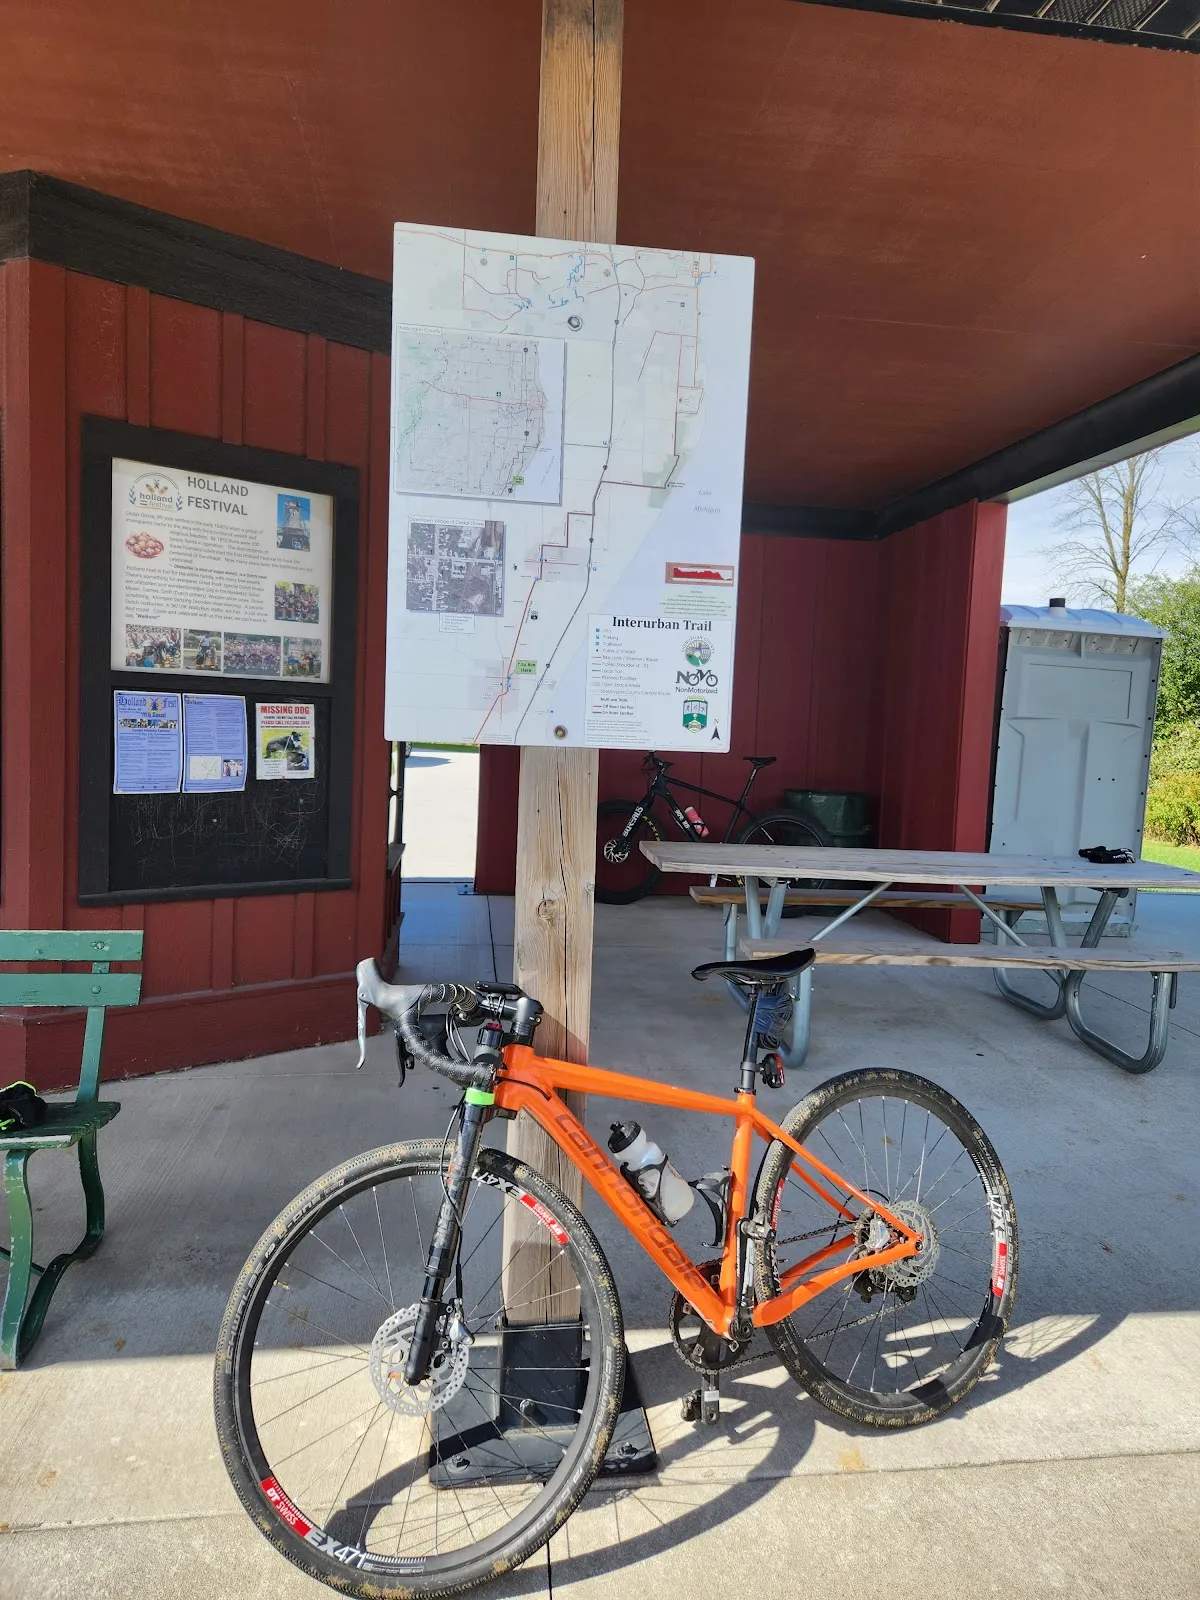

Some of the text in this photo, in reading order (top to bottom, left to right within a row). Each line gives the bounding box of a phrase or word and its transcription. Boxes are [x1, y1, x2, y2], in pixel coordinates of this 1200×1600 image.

[187, 476, 249, 497] HOLLAND
[139, 492, 173, 504] holland
[187, 496, 248, 516] FESTIVAL
[612, 616, 712, 632] Interurban Trail
[675, 686, 718, 694] NonMotorized
[260, 705, 310, 714] MISSING DOG
[555, 1114, 707, 1292] cannondale
[266, 1487, 300, 1526] DT SWISS
[304, 1528, 367, 1569] EX471
